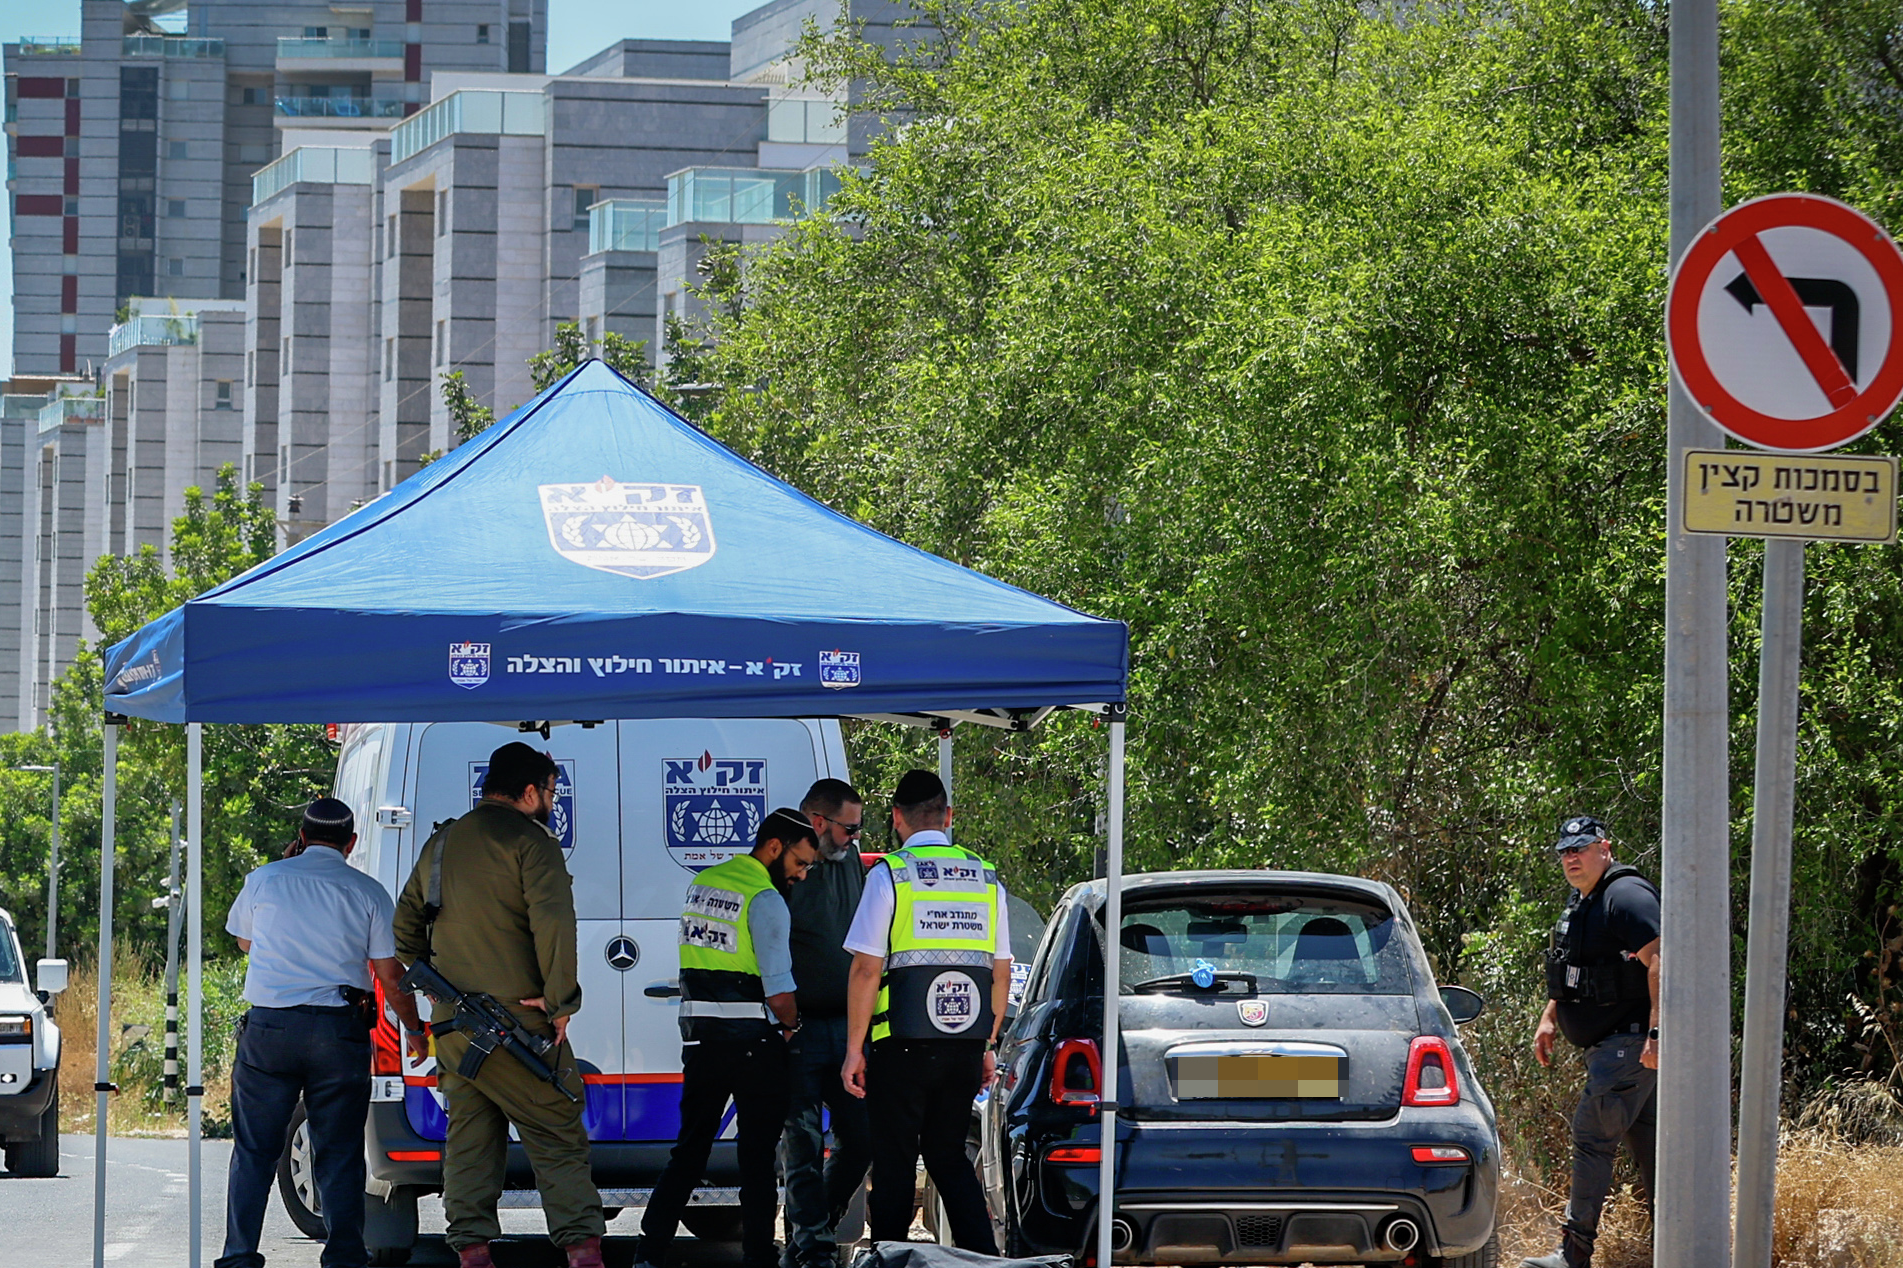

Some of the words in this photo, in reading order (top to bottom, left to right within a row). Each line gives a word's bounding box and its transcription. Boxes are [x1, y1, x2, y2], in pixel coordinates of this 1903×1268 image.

[1698, 462, 1760, 492] קצין
[1773, 466, 1880, 494] בסמכות
[1735, 499, 1842, 527] משטרה
[506, 653, 581, 673] והצלה
[587, 655, 652, 677] חילוץ
[665, 786, 696, 794] הצלה
[700, 786, 730, 796] חילוץ
[709, 849, 724, 860] של
[949, 910, 978, 920] מתנדב
[919, 919, 950, 930] ישראל
[951, 921, 983, 931] משטרת
